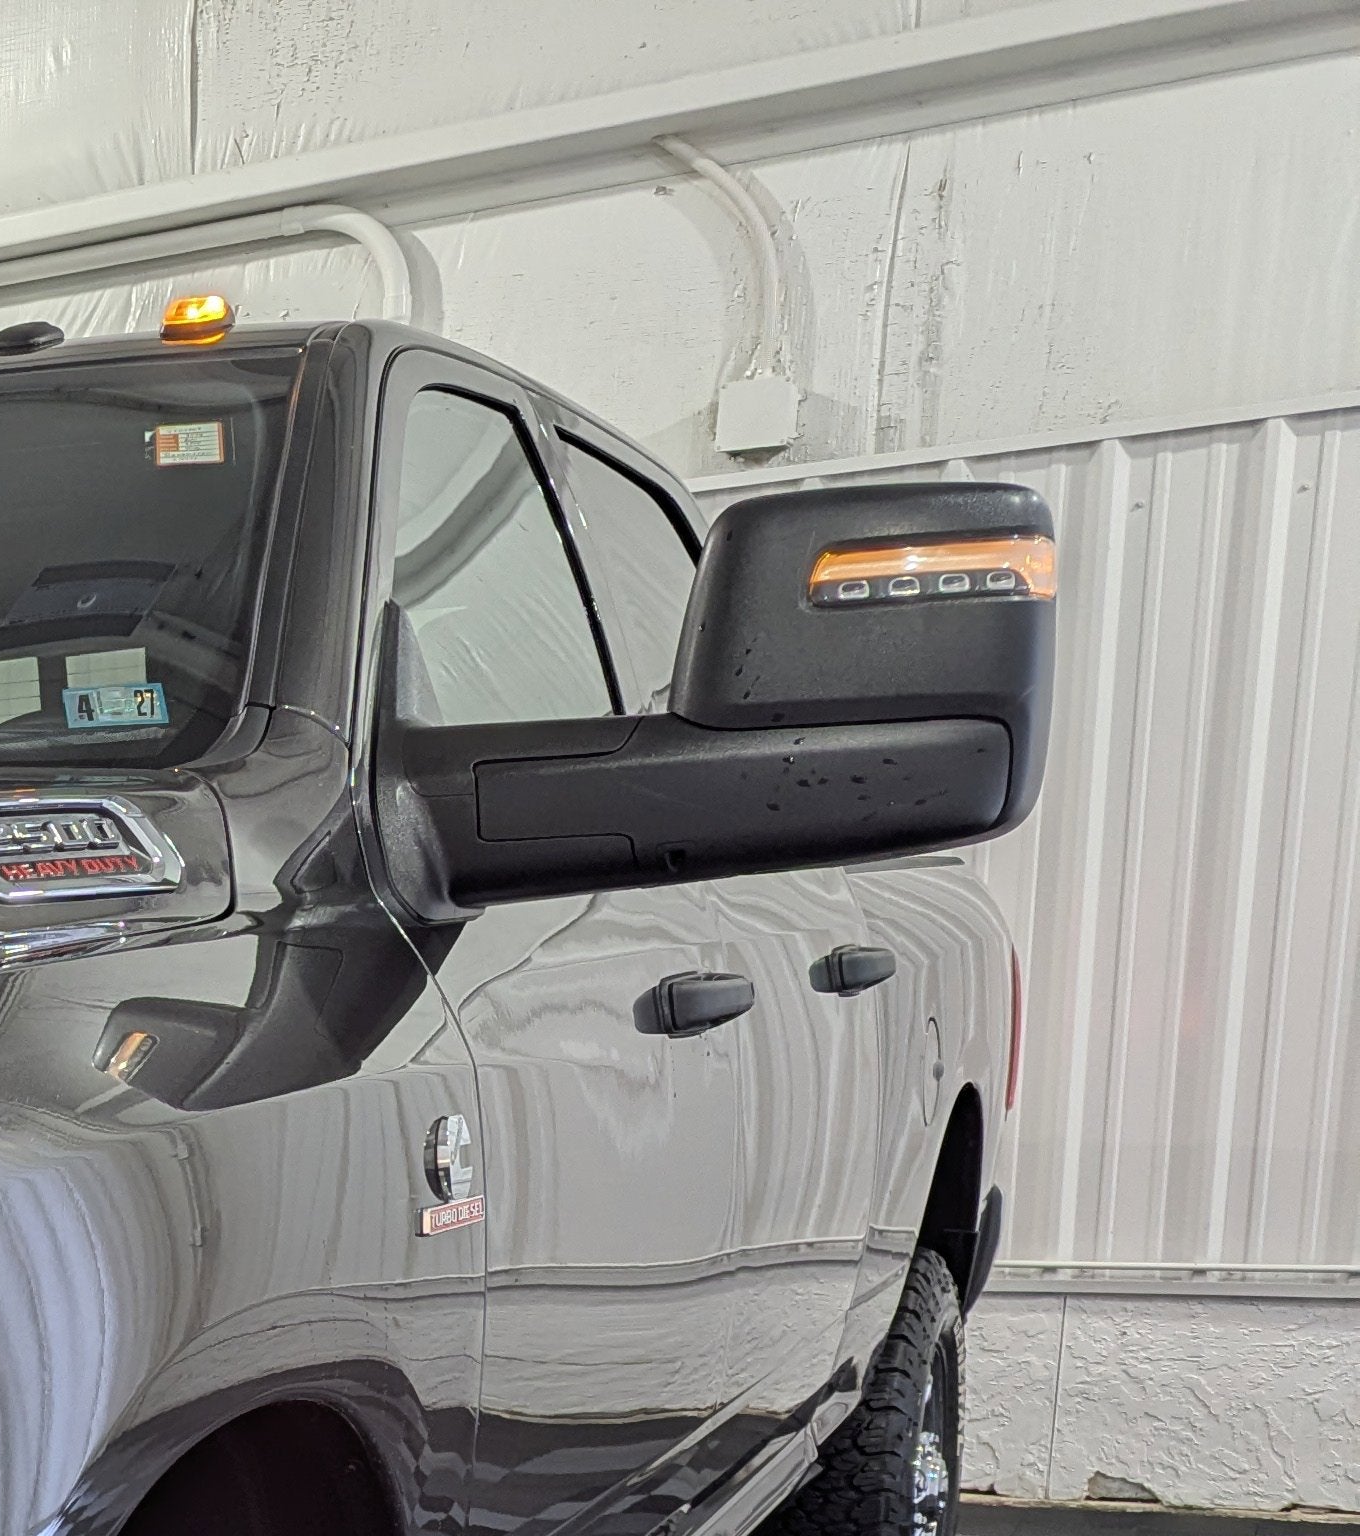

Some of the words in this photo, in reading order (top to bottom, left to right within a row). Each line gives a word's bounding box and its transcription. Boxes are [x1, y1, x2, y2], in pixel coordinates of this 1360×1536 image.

[0, 859, 79, 882] HEAVY
[81, 855, 143, 876] DUTY
[430, 1208, 458, 1229] TURBO
[458, 1201, 484, 1221] DIESEL
